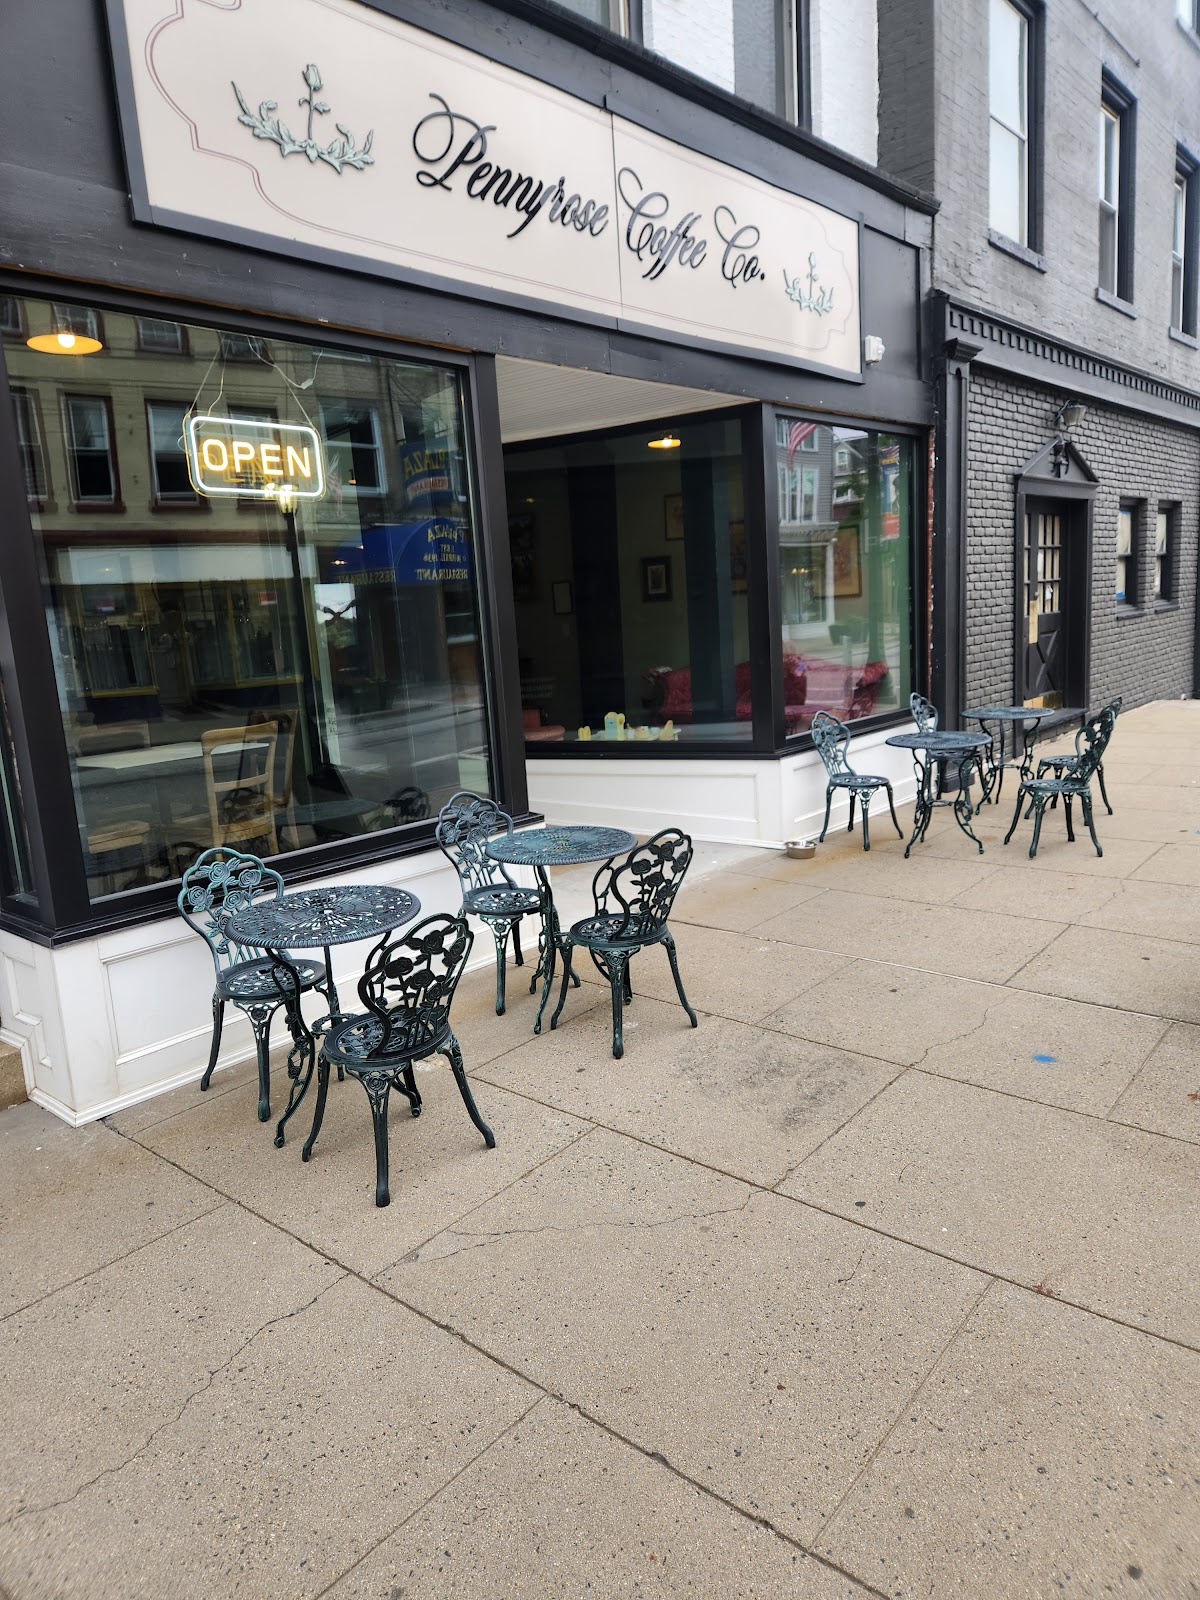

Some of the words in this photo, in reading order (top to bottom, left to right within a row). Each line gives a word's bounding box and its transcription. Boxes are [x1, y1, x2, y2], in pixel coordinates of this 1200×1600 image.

[413, 93, 609, 238] Pennyrose
[618, 167, 707, 280] Coffee
[714, 205, 765, 288] Co.
[202, 438, 311, 478] OPEN
